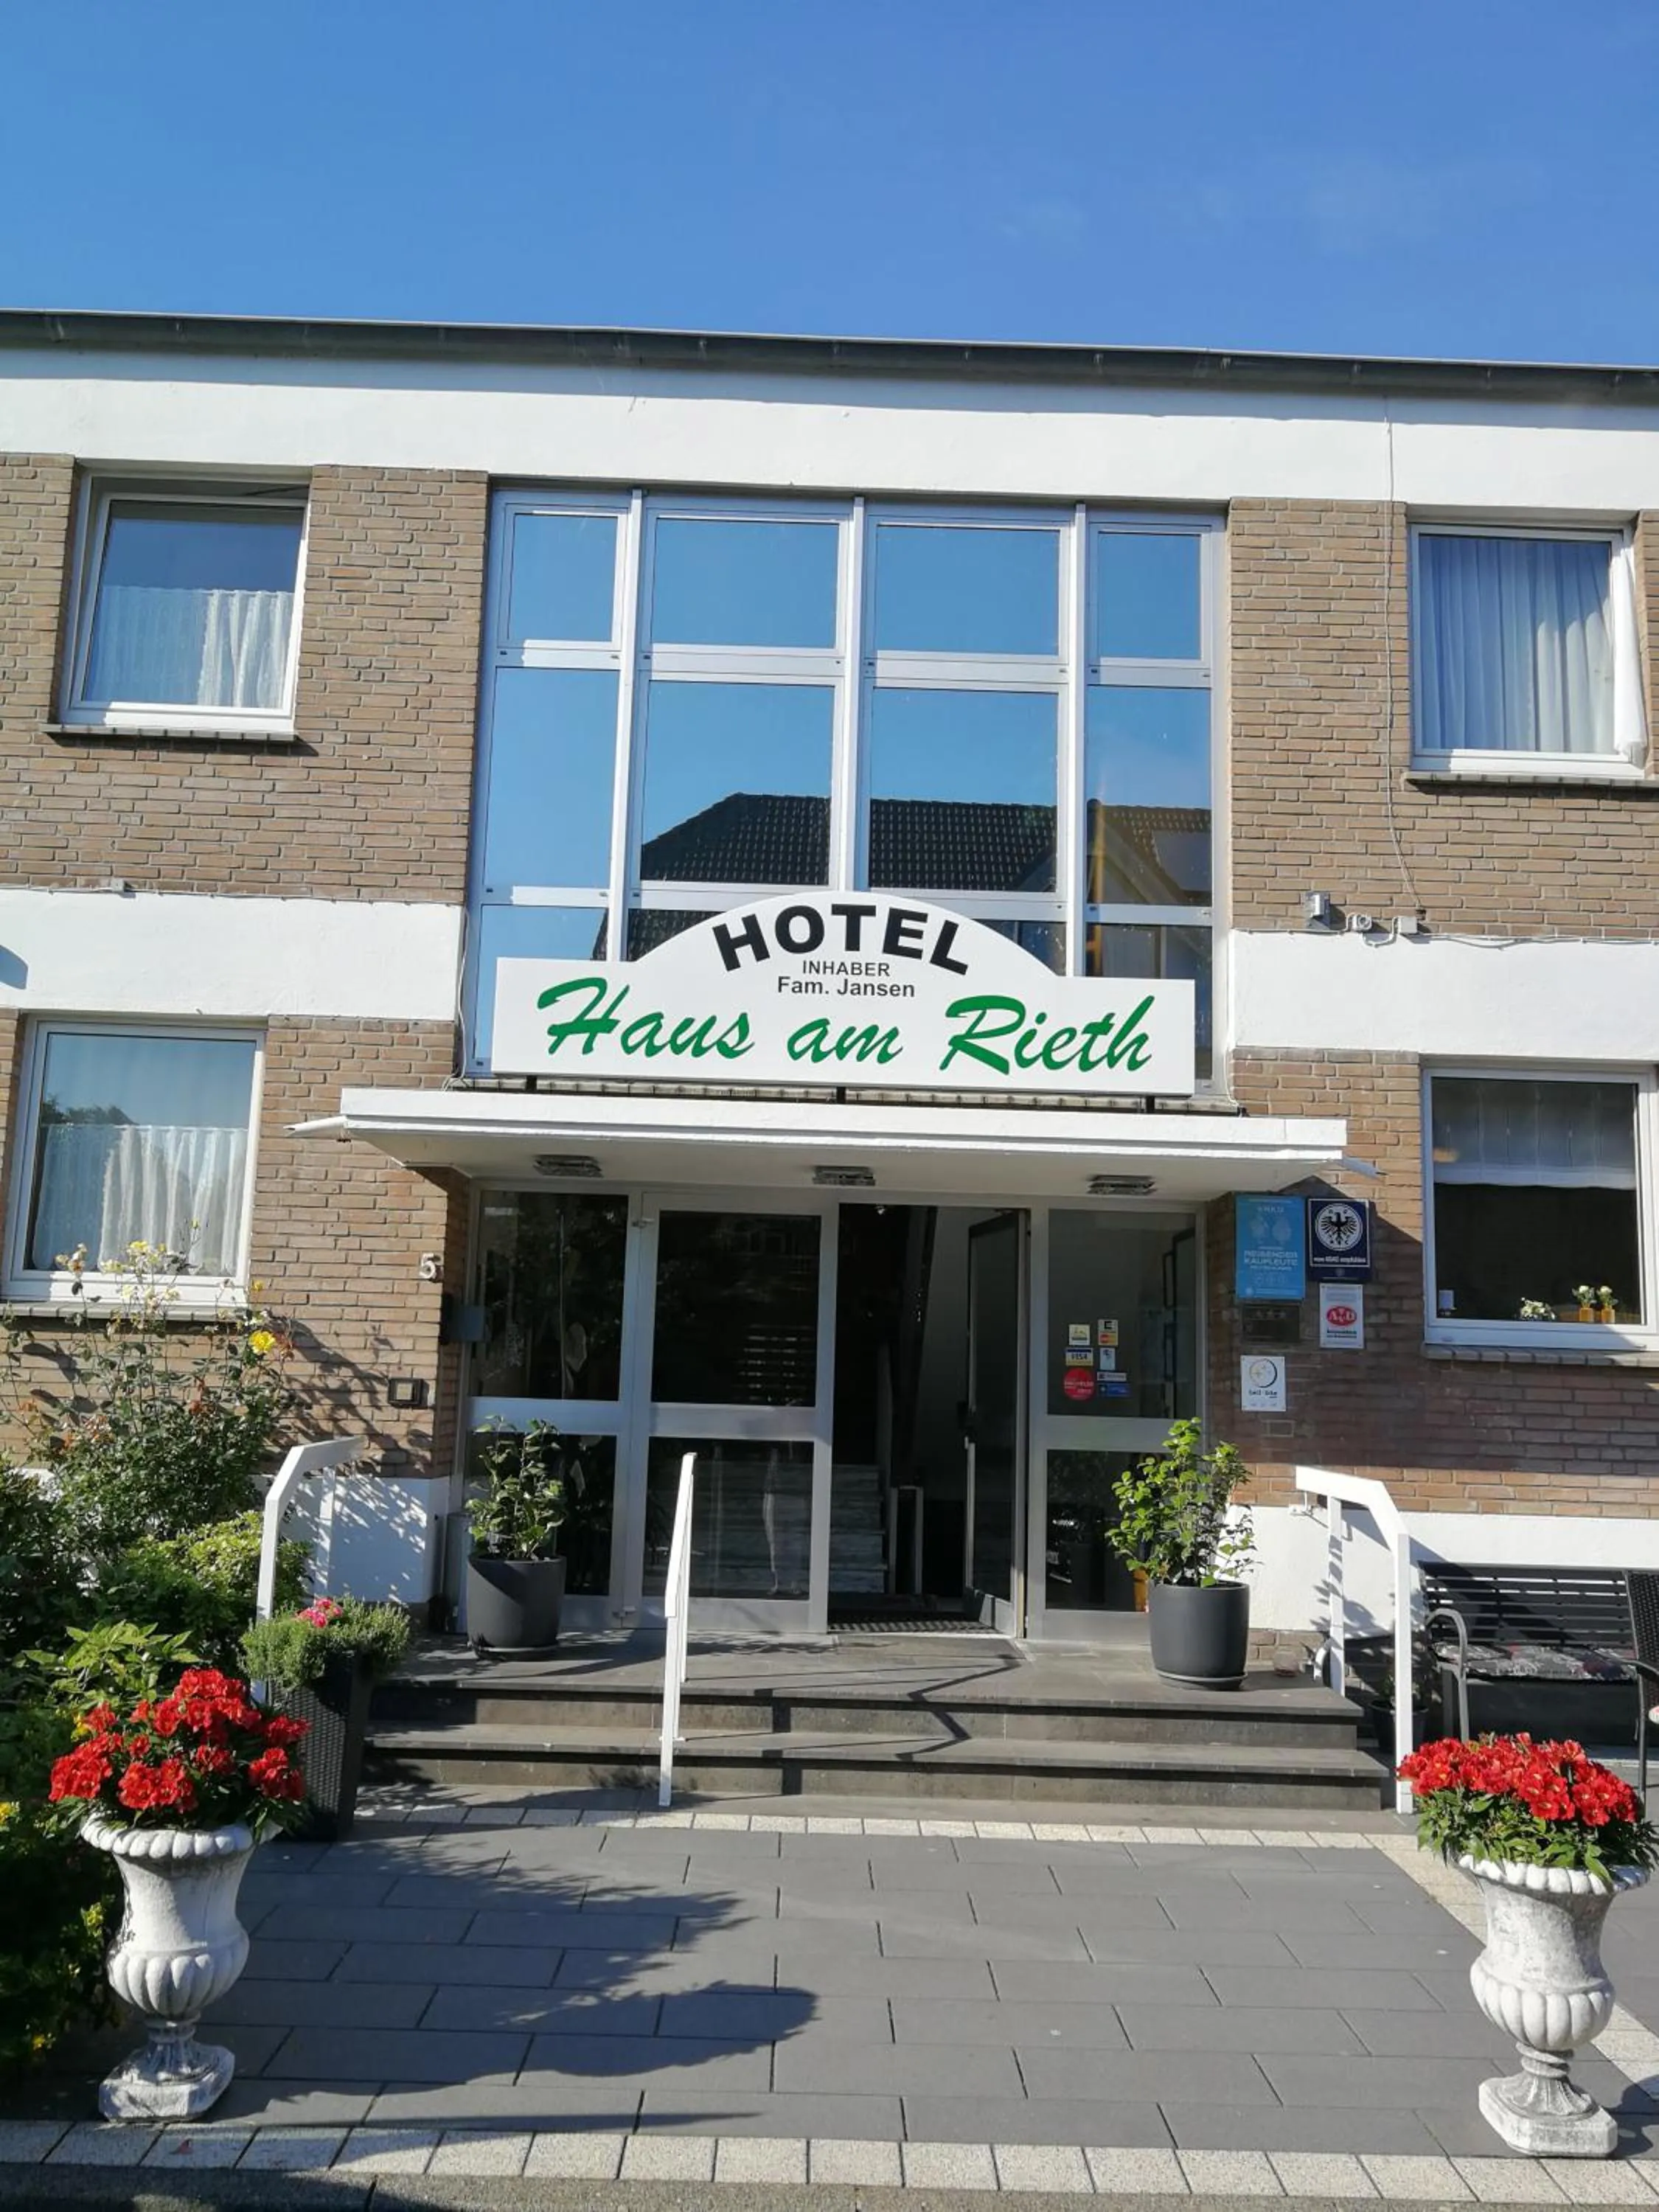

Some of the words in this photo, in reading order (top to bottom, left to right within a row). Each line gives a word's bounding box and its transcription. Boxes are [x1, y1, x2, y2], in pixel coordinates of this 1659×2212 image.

[712, 903, 968, 975] HOTEL
[803, 960, 890, 977] INHABER
[778, 975, 830, 995] Fam.
[837, 978, 915, 998] Jansen
[536, 976, 754, 1059] Haus
[786, 1017, 902, 1064] am
[940, 995, 1153, 1074] Rieth
[420, 1253, 436, 1279] 5
